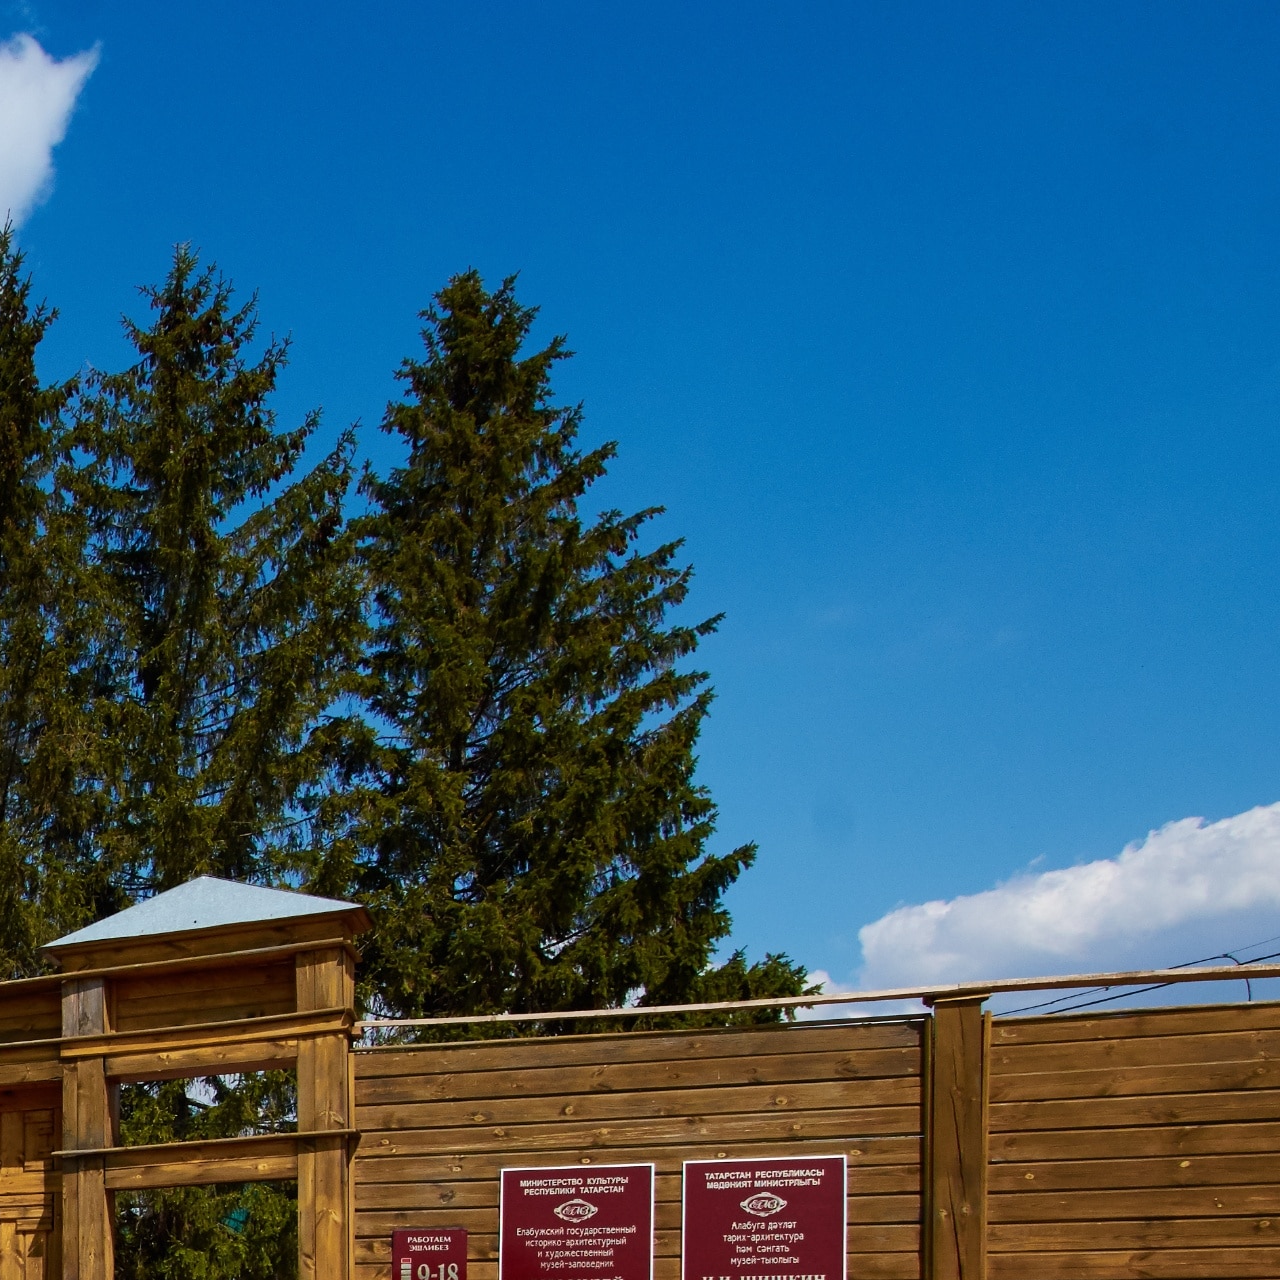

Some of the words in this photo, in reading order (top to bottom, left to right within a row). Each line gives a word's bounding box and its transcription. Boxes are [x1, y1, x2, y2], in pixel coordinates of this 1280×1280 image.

[704, 1172, 751, 1180] ТАТАРСТАН
[755, 1169, 825, 1179] РЕСПУБЛИКАСЫ
[520, 1178, 583, 1188] МИНИСТЕРСТВО
[586, 1177, 629, 1185] КУЛЬТУРЫ
[754, 1178, 821, 1188] МИНИСТРЛЫГЫ
[524, 1187, 576, 1196] РЕСПУБЛИКИ
[580, 1186, 624, 1194] ТАТАРСТАН
[516, 1227, 564, 1238] Елабужский
[566, 1225, 637, 1237] государственный
[731, 1221, 766, 1232] Алабуга
[525, 1237, 627, 1249] историко-архитектурный
[723, 1232, 805, 1244] тарих-архитектура
[545, 1248, 614, 1260] художественный
[756, 1245, 790, 1253] сәнгать
[540, 1260, 614, 1271] музей-заповедник
[730, 1255, 800, 1268] музей-тыюлыгы
